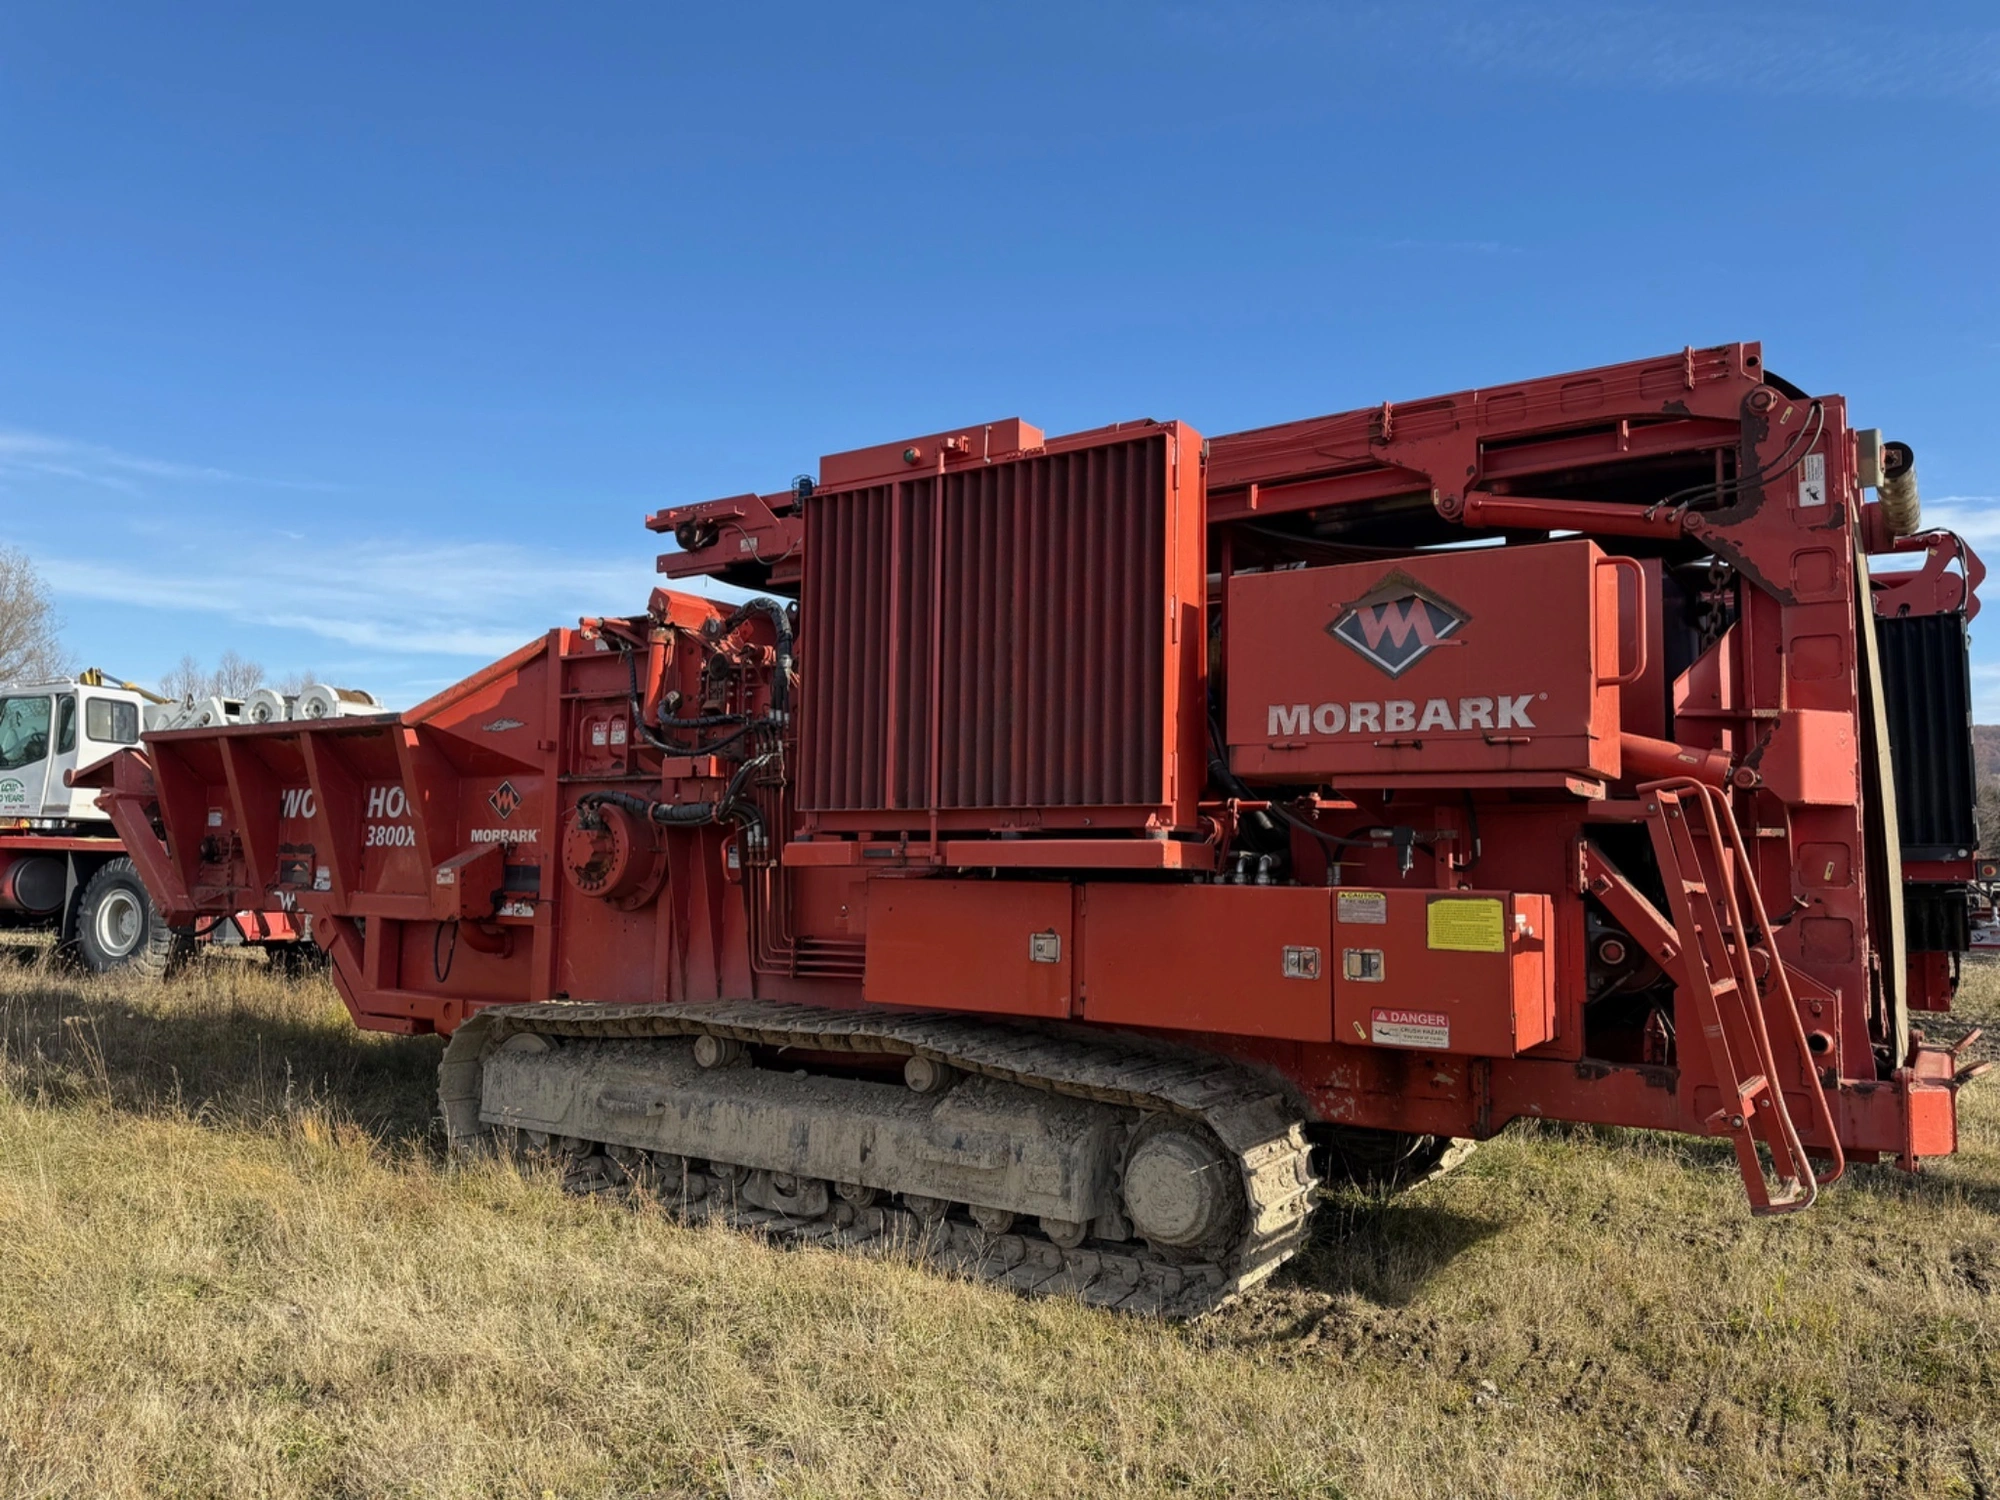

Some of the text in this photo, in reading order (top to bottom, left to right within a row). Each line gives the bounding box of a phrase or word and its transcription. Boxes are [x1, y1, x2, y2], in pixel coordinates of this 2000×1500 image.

[1267, 694, 1537, 736] MORBARK
[365, 825, 416, 846] 3800X
[1390, 1012, 1446, 1026] DANGER
